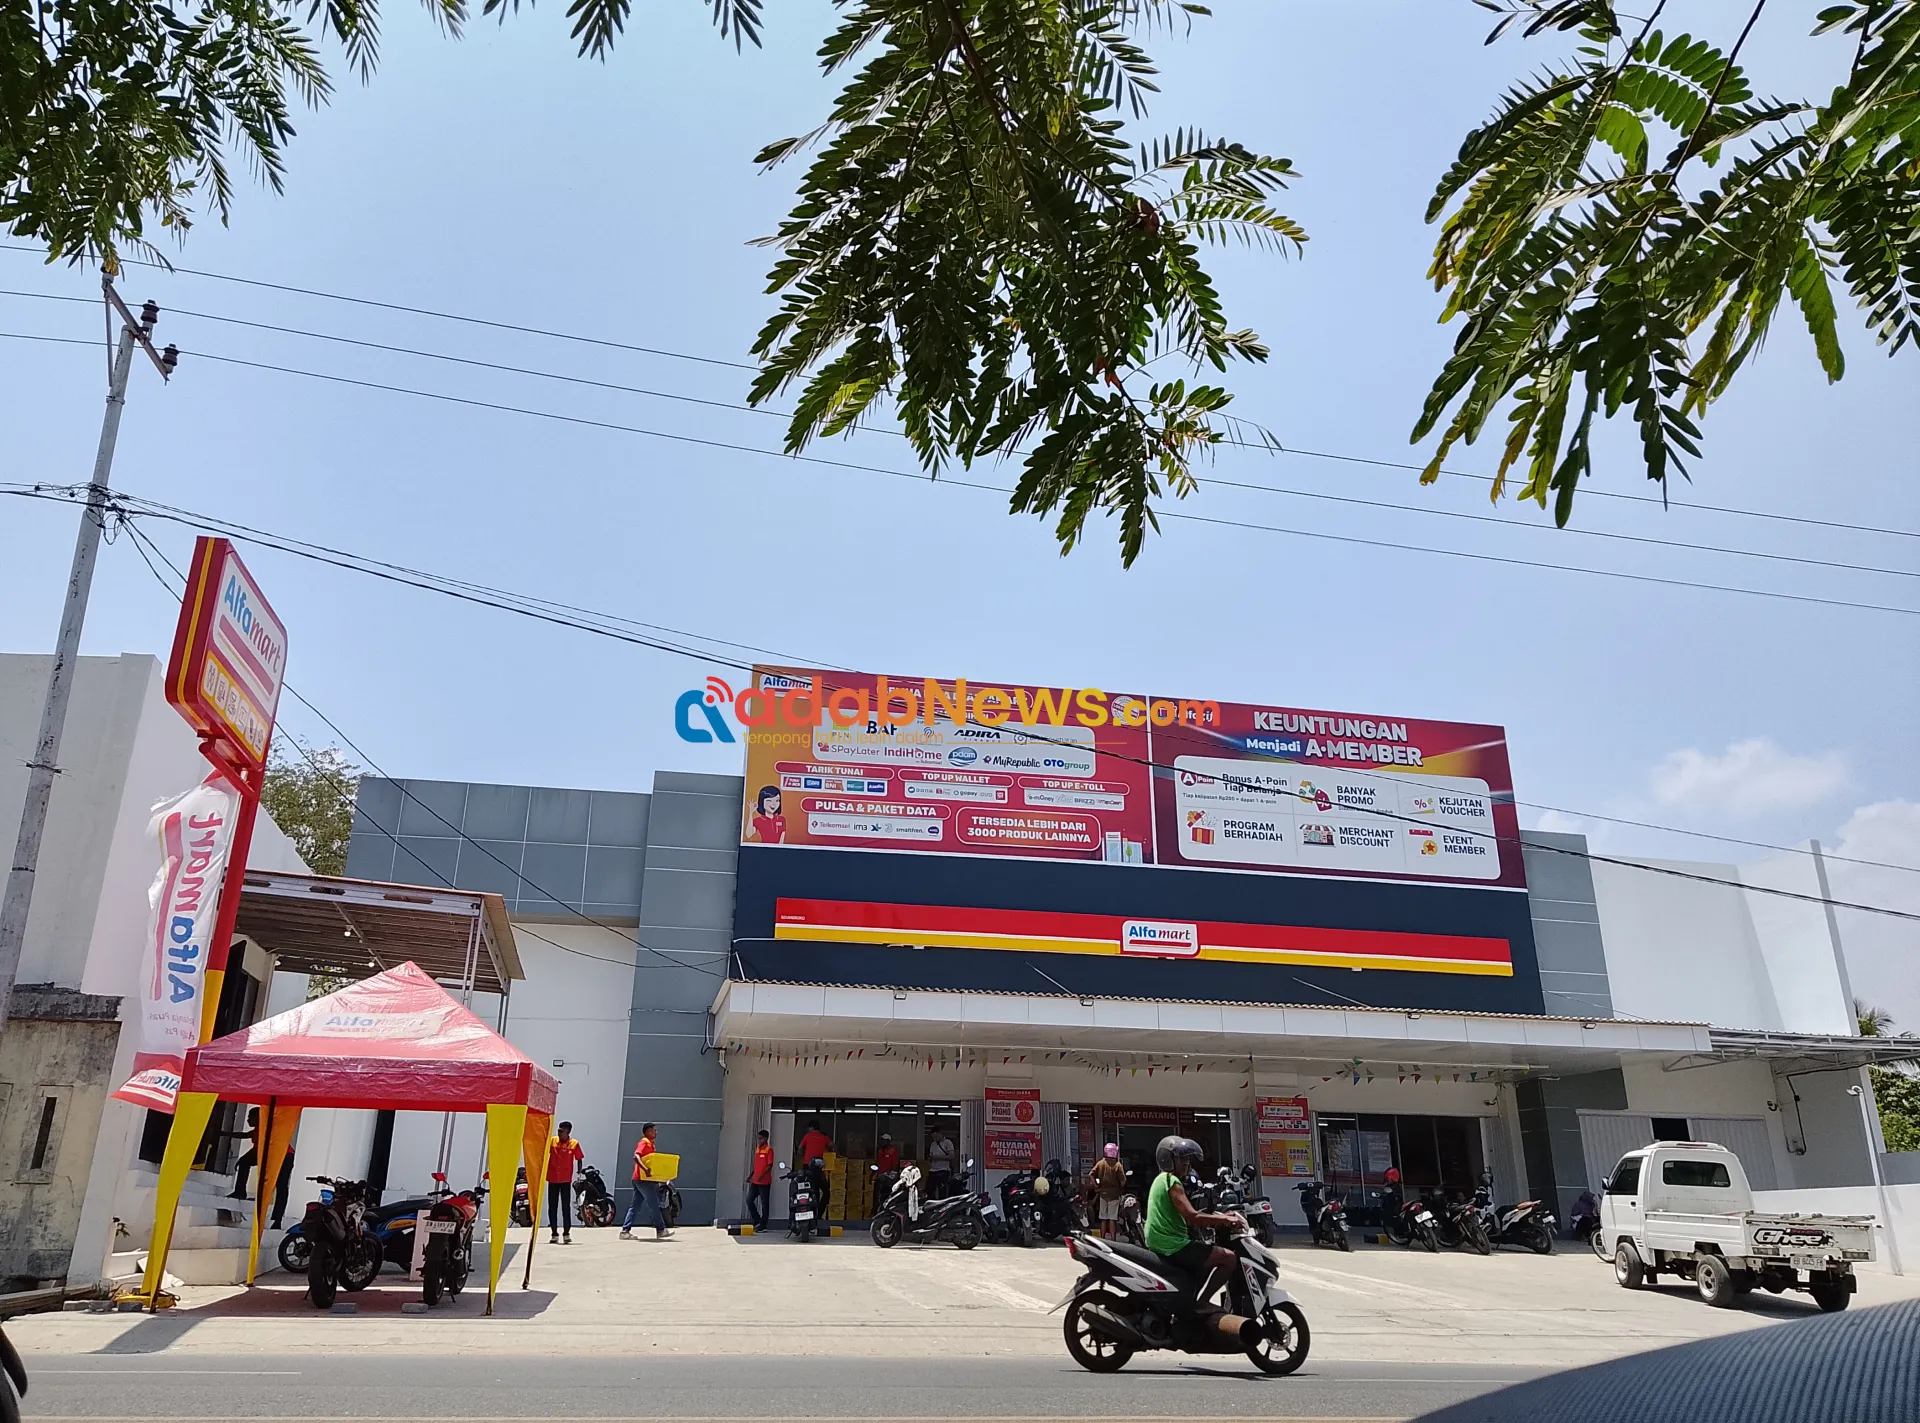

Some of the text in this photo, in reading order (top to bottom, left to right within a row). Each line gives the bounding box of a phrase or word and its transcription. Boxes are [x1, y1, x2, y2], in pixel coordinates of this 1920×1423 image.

[224, 574, 281, 674] Alfamart
[763, 676, 814, 690] Alfamar
[1253, 711, 1408, 742] KEUNTUNGAN
[954, 729, 1001, 739] ADIRA
[831, 744, 880, 758] SPayLater
[1246, 738, 1300, 753] Menjadi
[952, 750, 976, 759] pdam
[992, 756, 1041, 768] MyRepublic
[1043, 758, 1090, 771] OTOgroup
[805, 765, 864, 776] TARIK TUNAI
[922, 772, 990, 784] TOP UP WALLET
[1222, 773, 1287, 786] Bonus A-Poin
[1042, 780, 1105, 791] TOP UP E-TOLL
[1222, 782, 1244, 793] Tiap
[1336, 785, 1376, 797] BANYAK
[1337, 795, 1374, 805] PROMO
[1438, 797, 1482, 808] KEJUTAN
[815, 800, 937, 816] PULSA & PAKET DATA
[1440, 806, 1486, 817] VOUCHER
[819, 821, 850, 829] Telkomsel
[971, 816, 1086, 831] TERSEDIA LEBIH DARI
[1223, 819, 1275, 832] PROGRAM
[967, 827, 1091, 843] 3000 PRODUK LAINNYA
[1224, 829, 1283, 842] BERHADIAH
[1339, 826, 1395, 838] MERCHANT
[1340, 836, 1390, 848] DISCOUNT
[1443, 835, 1473, 845] EVENT
[1444, 845, 1486, 856] MEMBER
[1103, 1110, 1140, 1119] SELAMAT
[1142, 1111, 1176, 1120] DATANG
[990, 1140, 1037, 1150] MILYARAN
[995, 1148, 1032, 1157] RUPIAH
[1754, 1228, 1823, 1245] Ghee
